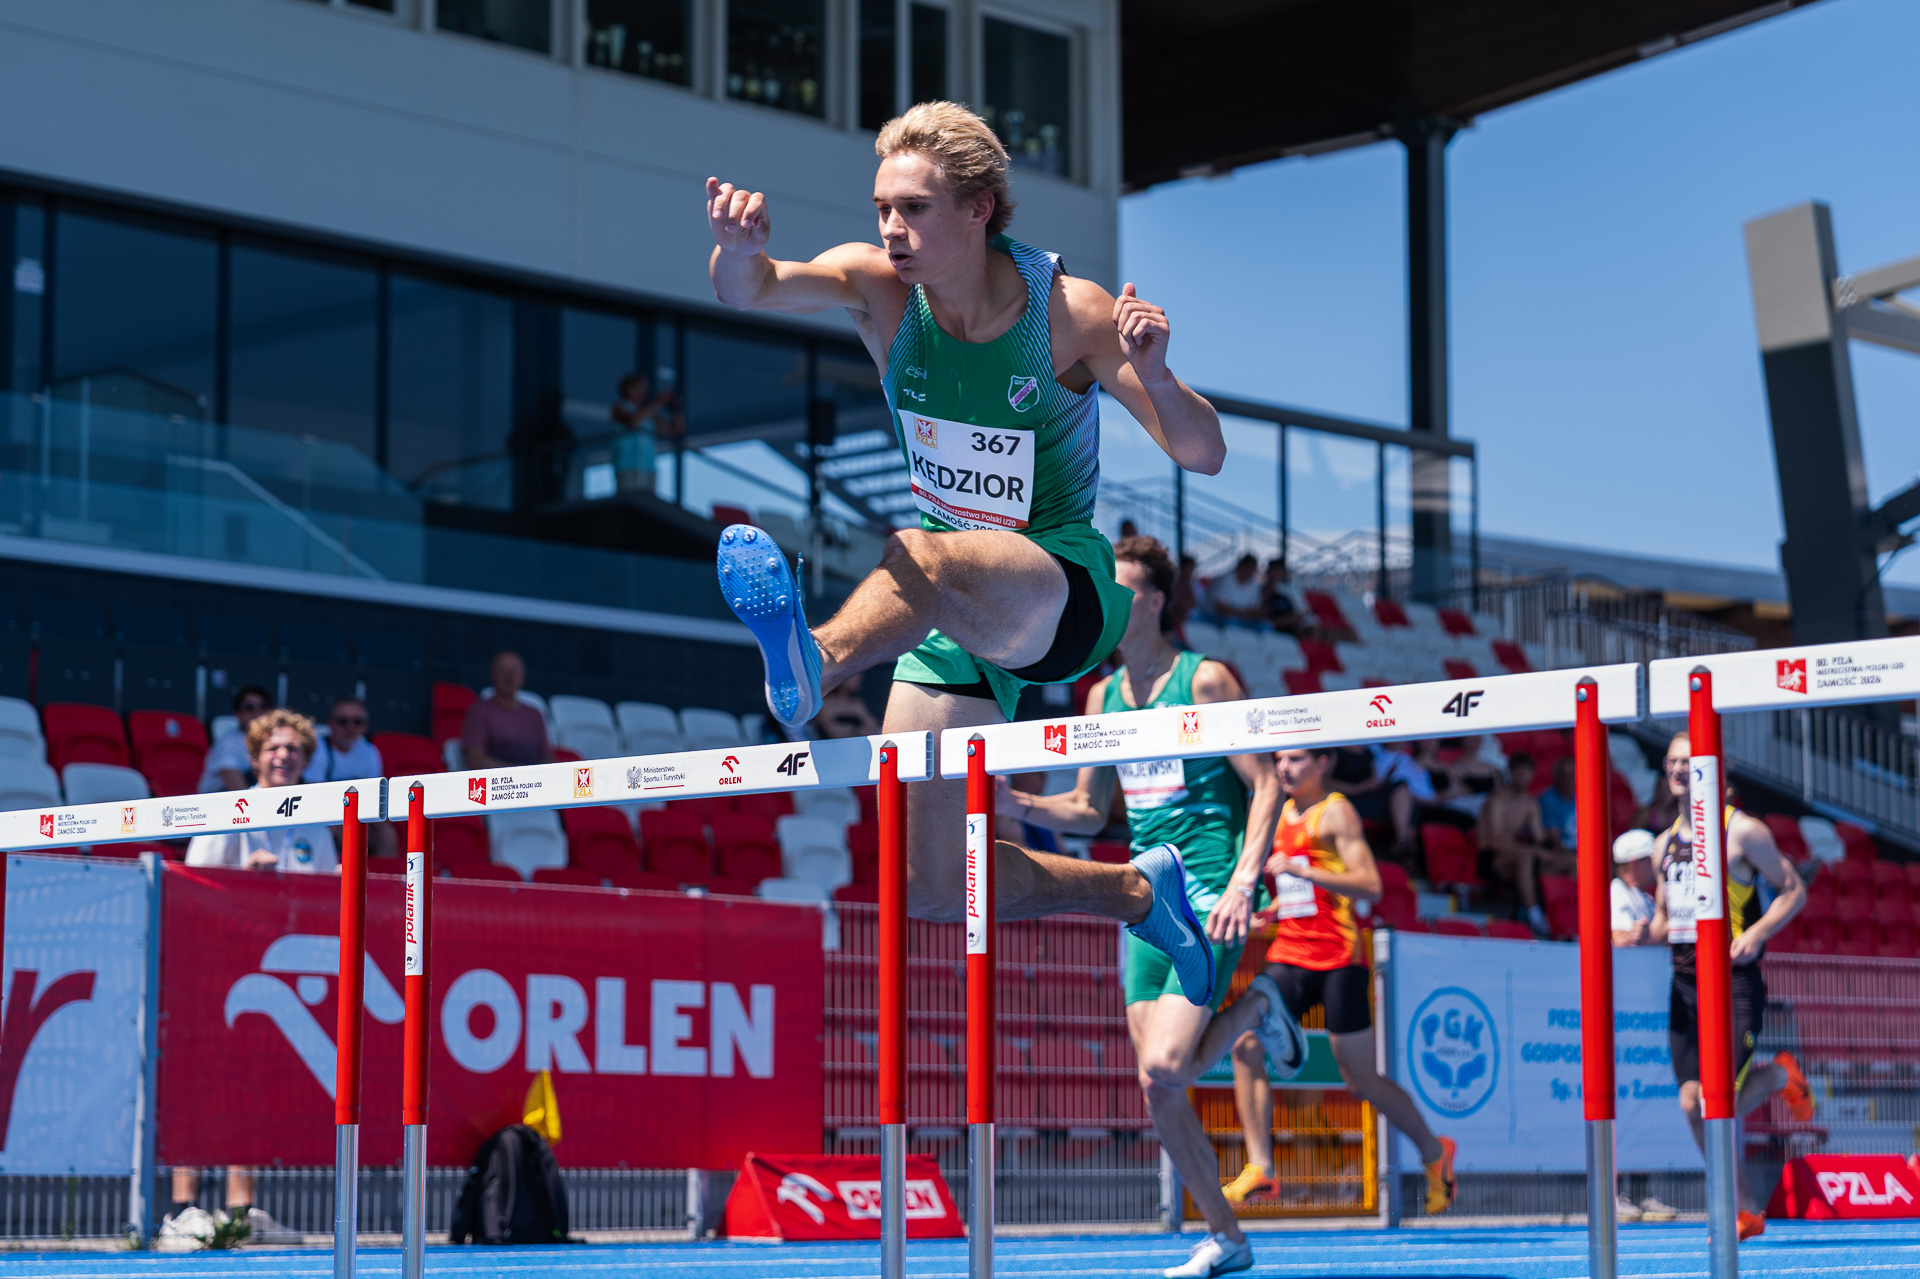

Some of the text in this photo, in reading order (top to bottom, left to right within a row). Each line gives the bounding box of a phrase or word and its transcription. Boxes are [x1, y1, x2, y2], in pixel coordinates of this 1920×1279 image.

[971, 432, 1021, 456] 367
[911, 450, 1025, 503] KĘDZIOR
[931, 505, 971, 531] ZAMOŚĆ
[940, 502, 980, 519] Mistrzostwa
[981, 512, 1002, 525] Polski
[1002, 518, 1017, 528] U20
[1831, 656, 1853, 666] PZLA
[1817, 675, 1881, 688] ZAMOŚĆ 2026
[1442, 690, 1484, 717] 4F
[1267, 707, 1308, 716] Ministerstwo
[1073, 722, 1100, 732] 80. PZLA
[1267, 718, 1288, 727] Sportu
[1293, 714, 1322, 725] Turystyki
[1366, 718, 1396, 729] ORLEN
[1073, 731, 1107, 740] MISTRZOSTWA
[1179, 732, 1201, 744] PZLA
[1073, 738, 1120, 750] ZAMOŚĆ 2026
[643, 766, 675, 774] Ministerstwo
[777, 752, 809, 776] 4F
[491, 776, 513, 785] 80. PZLA
[643, 775, 660, 783] Sportu
[663, 772, 686, 781] Turystyki
[719, 776, 742, 786] ORLEN
[491, 790, 529, 801] ZAMOŚĆ 2026
[574, 787, 592, 797] PZLA
[277, 796, 302, 817] 4F
[232, 817, 250, 825] ORLEN
[1691, 798, 1712, 878] polanik
[966, 848, 980, 919] polanik
[401, 882, 417, 944] polanik
[440, 968, 776, 1080] ORLEN
[1421, 1008, 1484, 1049] PGK
[1816, 1171, 1914, 1206] PZLA
